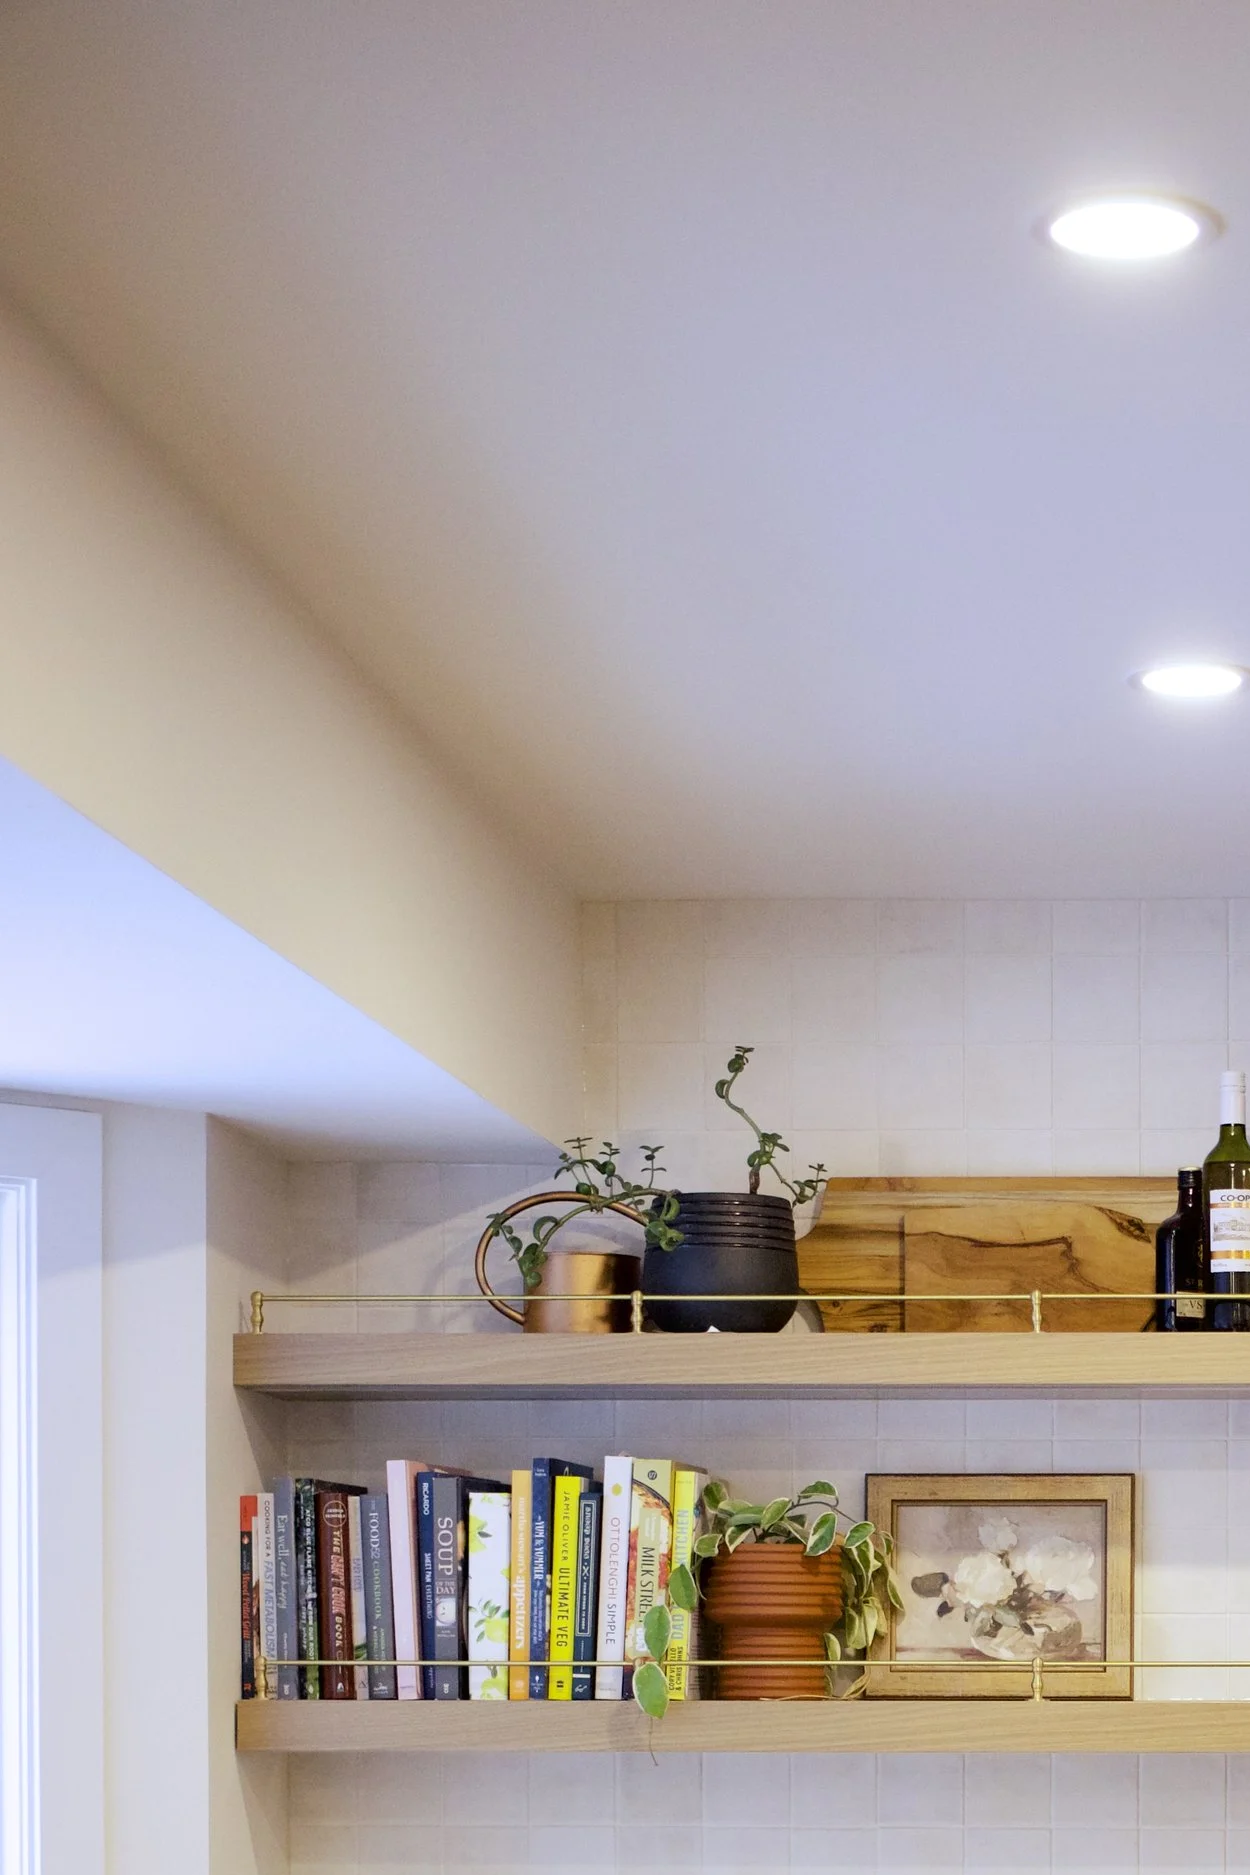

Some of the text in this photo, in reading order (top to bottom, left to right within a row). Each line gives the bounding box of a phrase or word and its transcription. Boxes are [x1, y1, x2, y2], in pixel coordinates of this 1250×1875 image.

[422, 1482, 430, 1516] RICARDO
[277, 1515, 288, 1533] Eat
[369, 1512, 381, 1559] FOOD52
[534, 1521, 545, 1538] YUM
[674, 1509, 689, 1565] KITCHEN
[277, 1535, 290, 1560] well,
[332, 1530, 341, 1553] THE
[437, 1517, 454, 1576] SOUP
[264, 1560, 274, 1587] FAST
[534, 1547, 545, 1580] YUMMER
[556, 1491, 571, 1647] JAMIE OLIVER ULTIMATE VEG
[641, 1547, 656, 1577] MILK
[373, 1560, 383, 1620] COOKBOOK
[436, 1587, 456, 1595] DAY
[605, 1517, 621, 1645] OTTOLENGHI SIMPLE
[512, 1575, 526, 1649] appetizers
[639, 1580, 655, 1623] STRE
[264, 1588, 275, 1658] METABOLISM
[335, 1616, 343, 1647] BOOK
